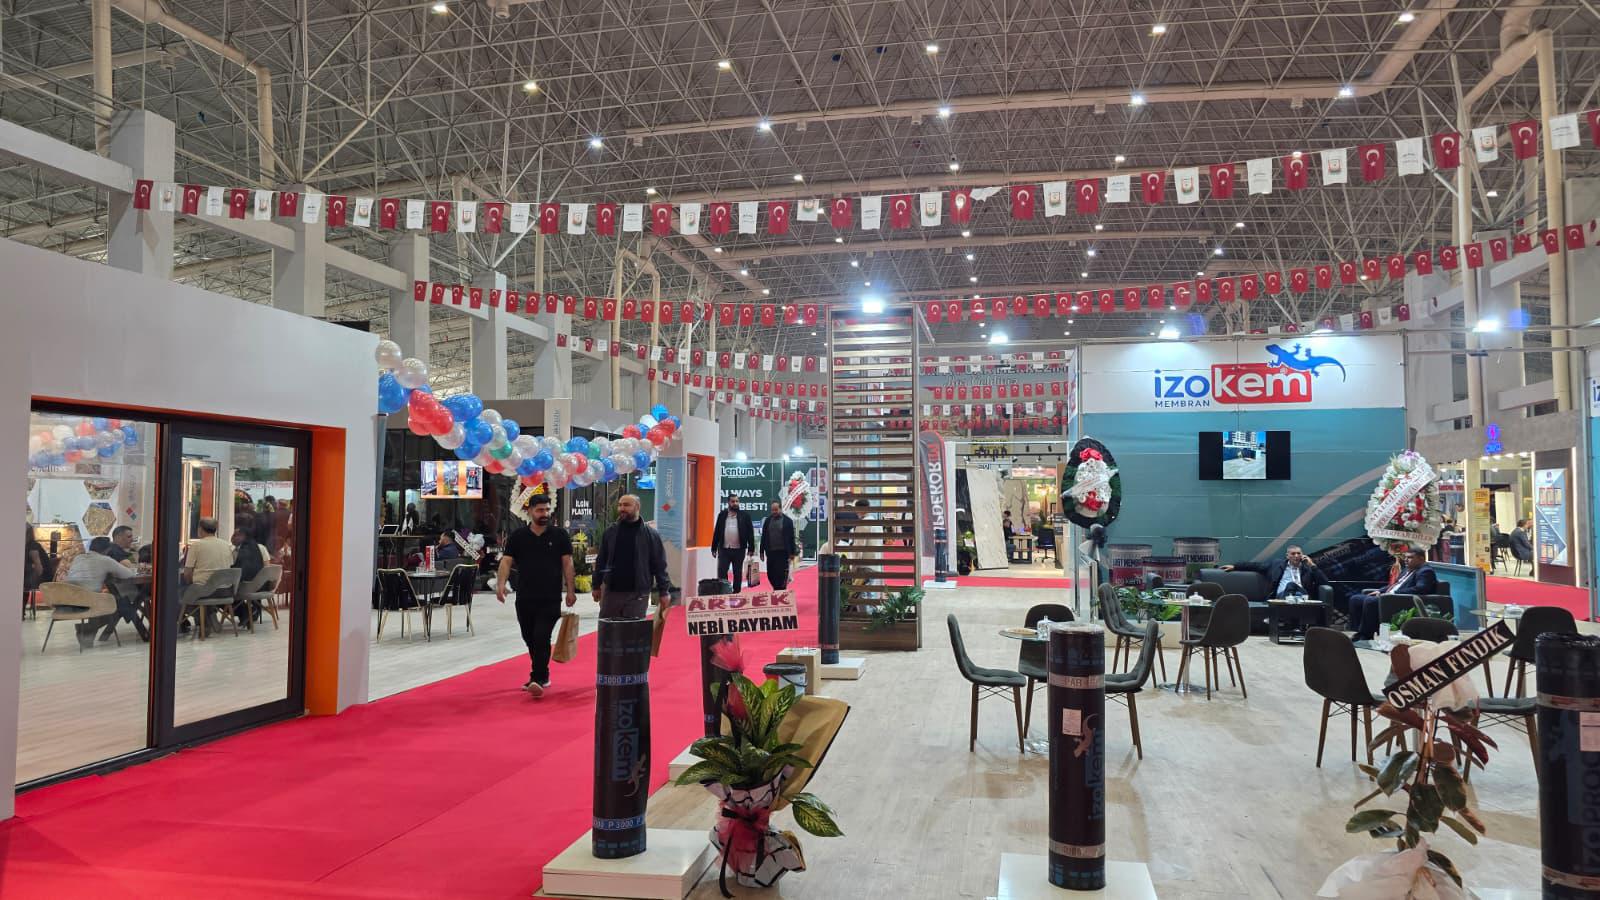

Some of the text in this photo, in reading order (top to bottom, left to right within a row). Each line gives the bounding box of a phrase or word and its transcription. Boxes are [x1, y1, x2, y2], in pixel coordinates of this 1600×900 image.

[1154, 368, 1307, 398] izokem
[1155, 399, 1210, 409] MEMBRAN
[688, 593, 791, 612] ARDEK
[688, 615, 799, 635] NEBİ BAYRAM
[1388, 625, 1510, 709] OSMAN FINDIK
